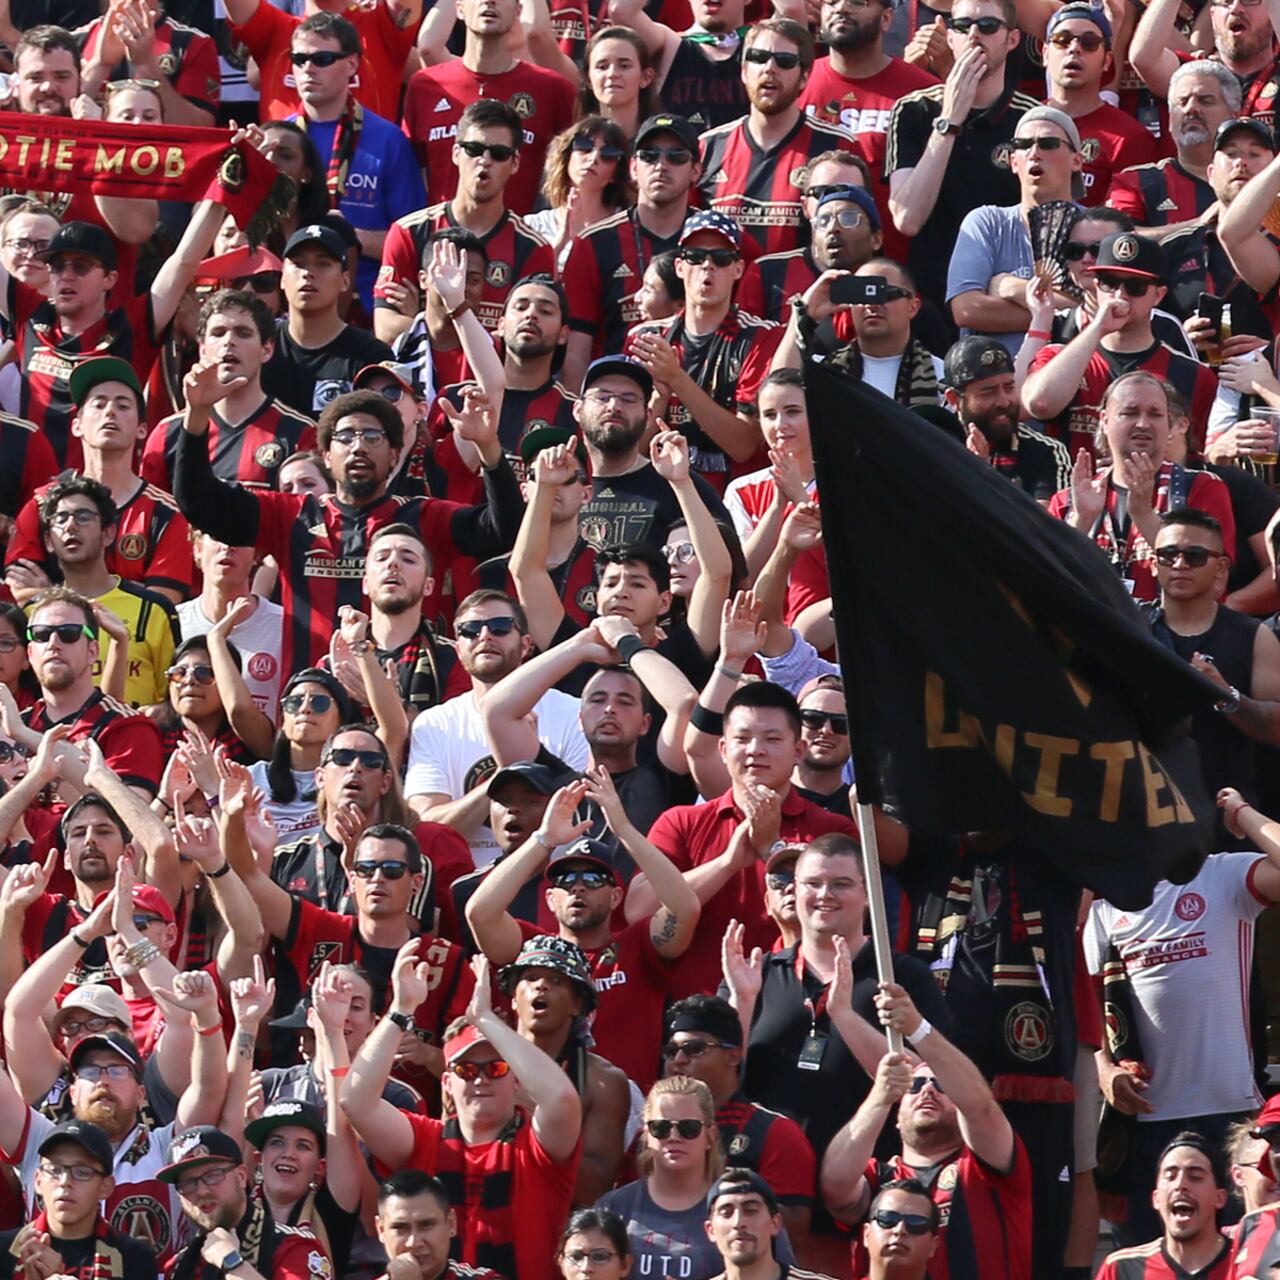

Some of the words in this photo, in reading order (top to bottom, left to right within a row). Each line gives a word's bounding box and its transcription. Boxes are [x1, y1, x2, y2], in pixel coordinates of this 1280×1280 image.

[672, 75, 747, 105] ATLAN
[429, 122, 459, 141] ATLA
[94, 143, 186, 178] MOB
[711, 205, 762, 217] AMERICAN
[764, 205, 802, 218] FAMILY
[579, 502, 647, 513] AUGURAL
[613, 515, 653, 542] 17
[305, 556, 355, 568] AMERICAN
[303, 567, 367, 579] INSURA
[924, 671, 1195, 827] UITE
[1167, 938, 1206, 955] FAMILY
[595, 971, 626, 991] NITED
[640, 1254, 691, 1278] UTD
